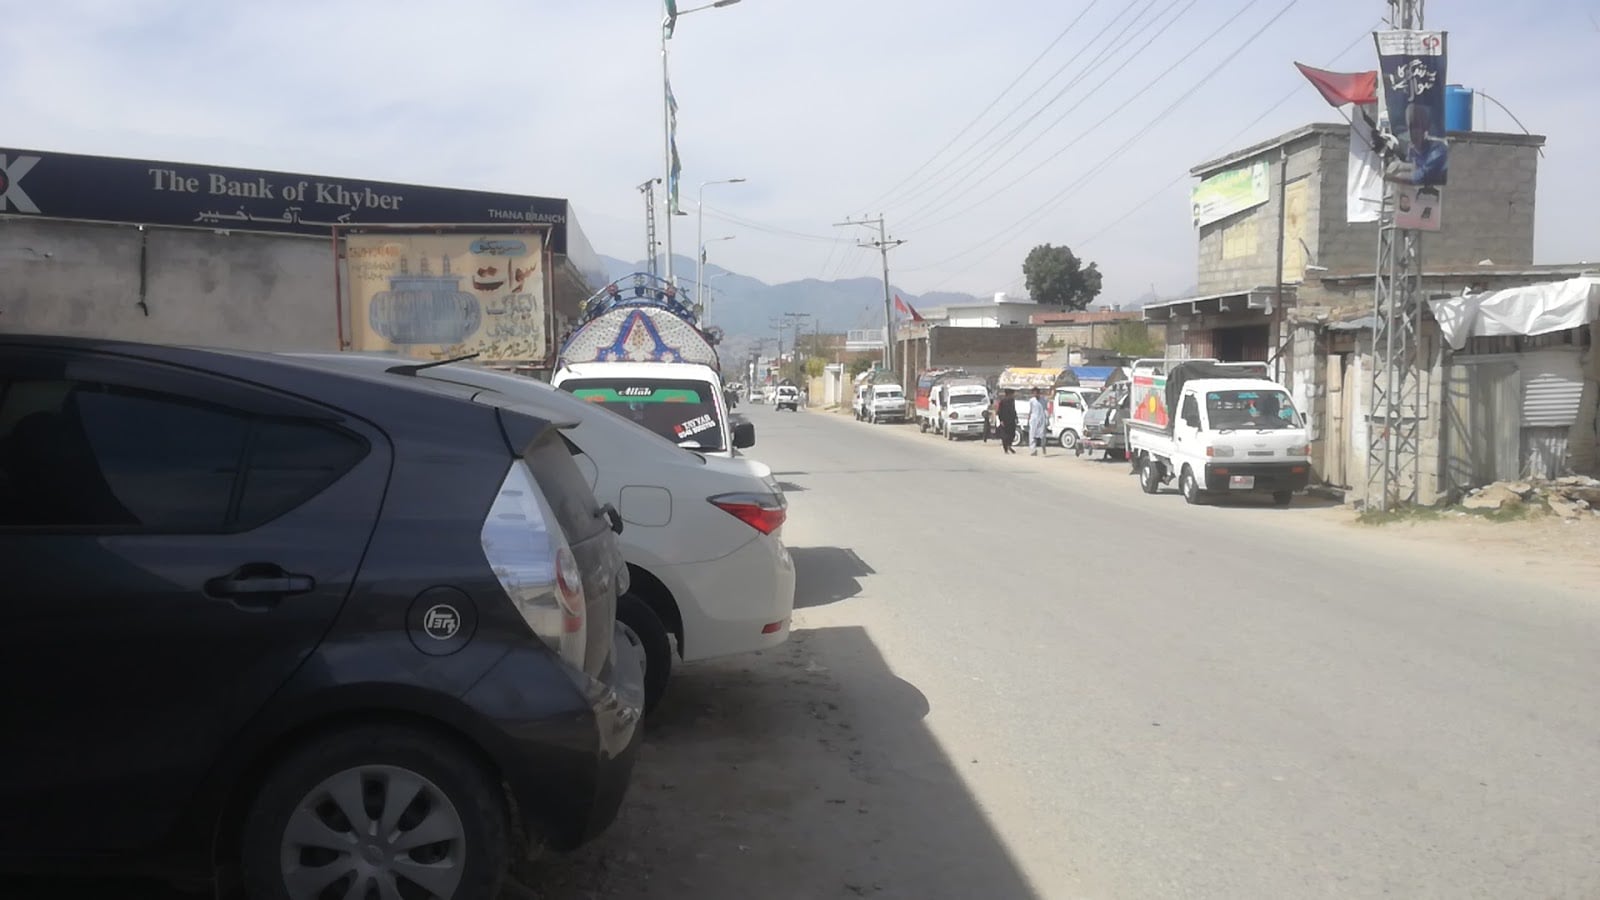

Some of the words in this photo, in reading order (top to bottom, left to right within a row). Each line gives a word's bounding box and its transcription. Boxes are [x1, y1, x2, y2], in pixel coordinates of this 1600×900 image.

[148, 168, 200, 193] The
[208, 173, 274, 200] Bank
[282, 180, 309, 202] of
[315, 182, 404, 212] Khyber
[488, 208, 524, 220] THANA
[524, 211, 566, 225] BRANCH
[472, 258, 537, 294] سوات
